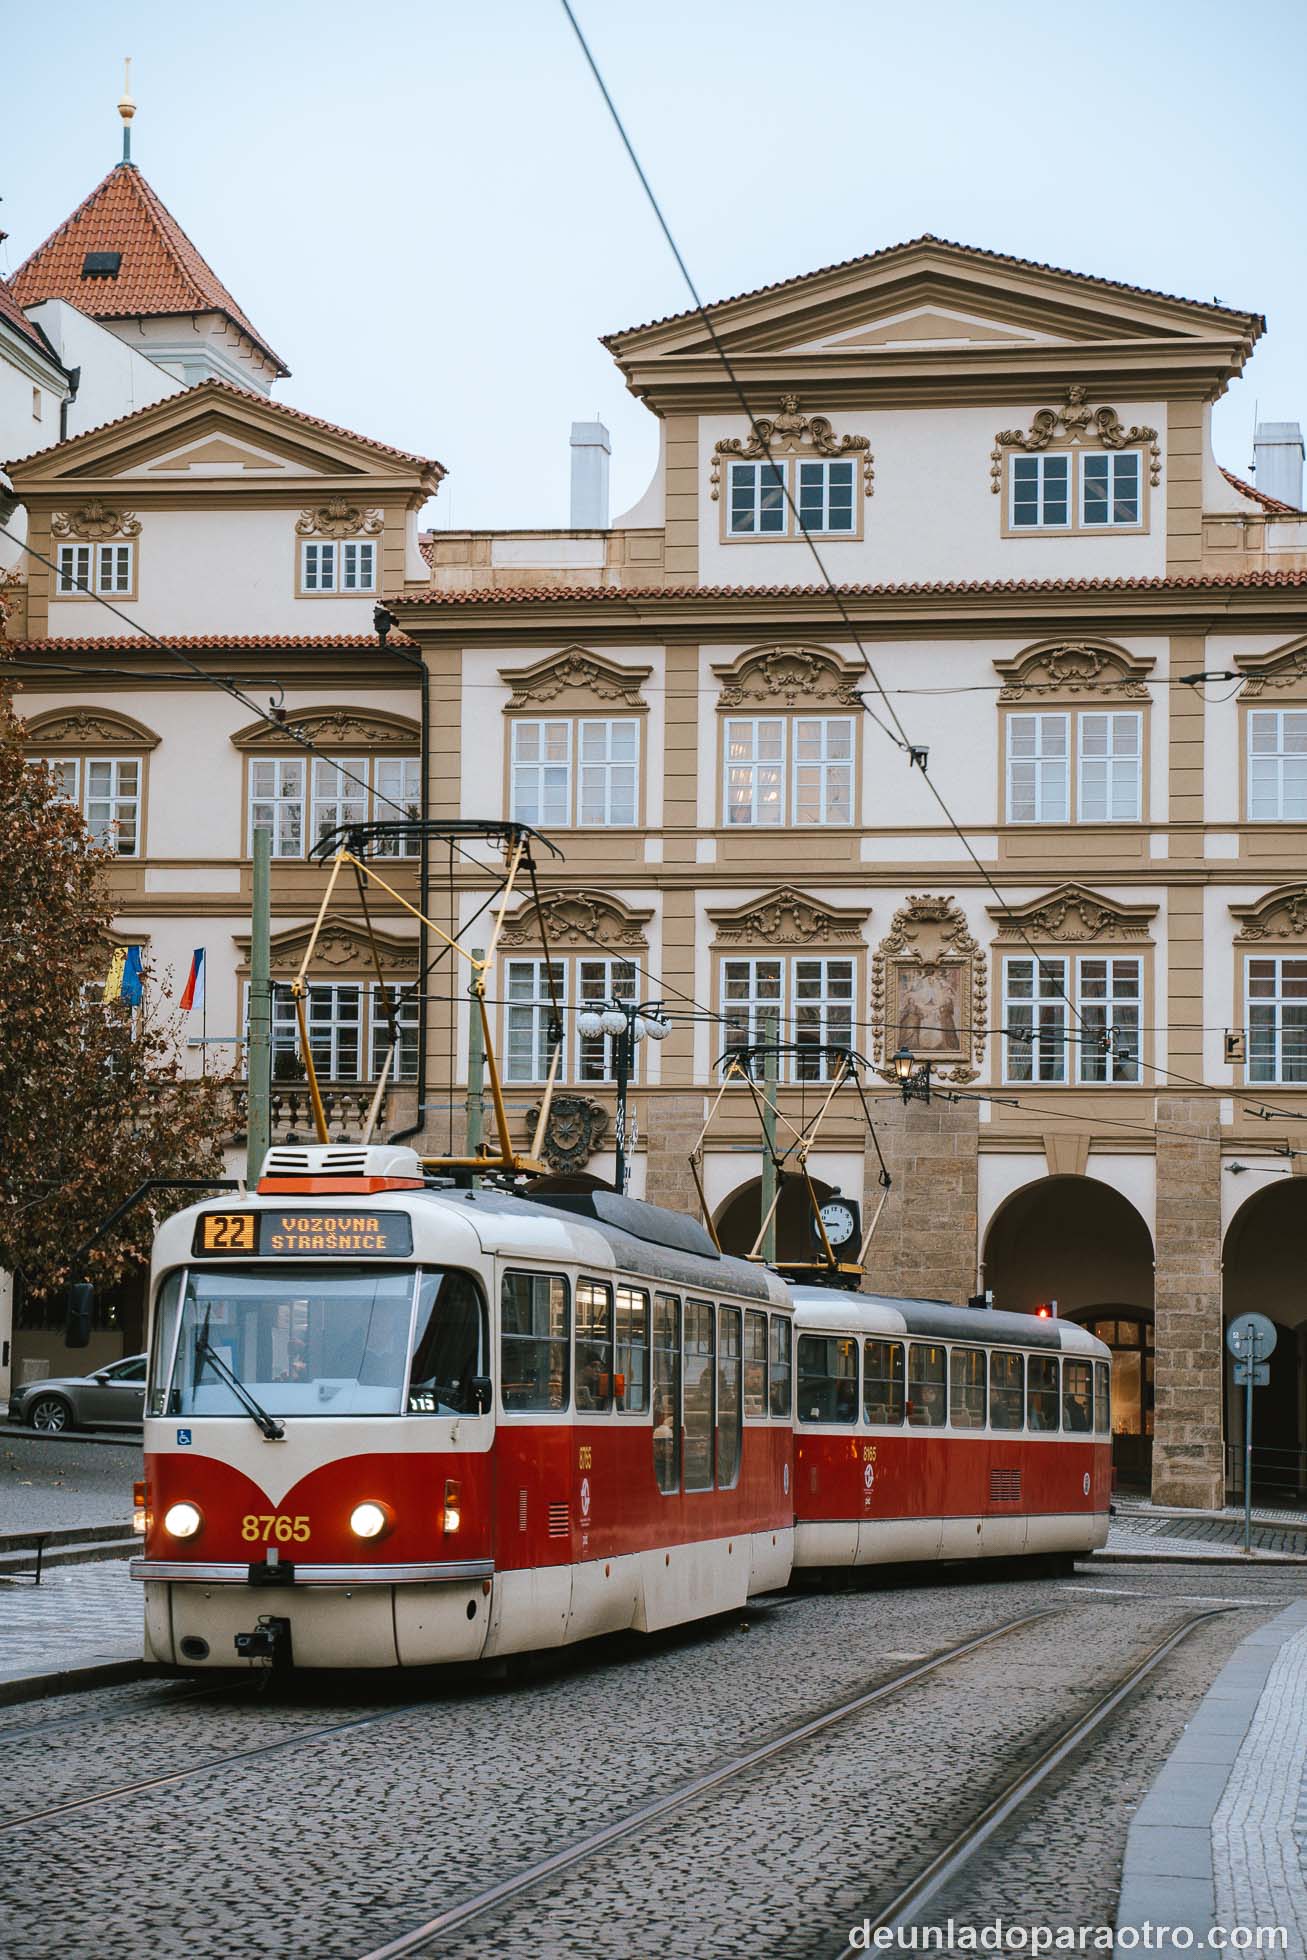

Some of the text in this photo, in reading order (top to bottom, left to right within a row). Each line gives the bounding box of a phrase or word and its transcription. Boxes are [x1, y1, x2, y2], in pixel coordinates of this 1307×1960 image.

[213, 1217, 245, 1248] 22
[282, 1218, 380, 1232] VOZOVNA
[271, 1232, 387, 1249] STRAŠNICE
[241, 1515, 311, 1542] 8765
